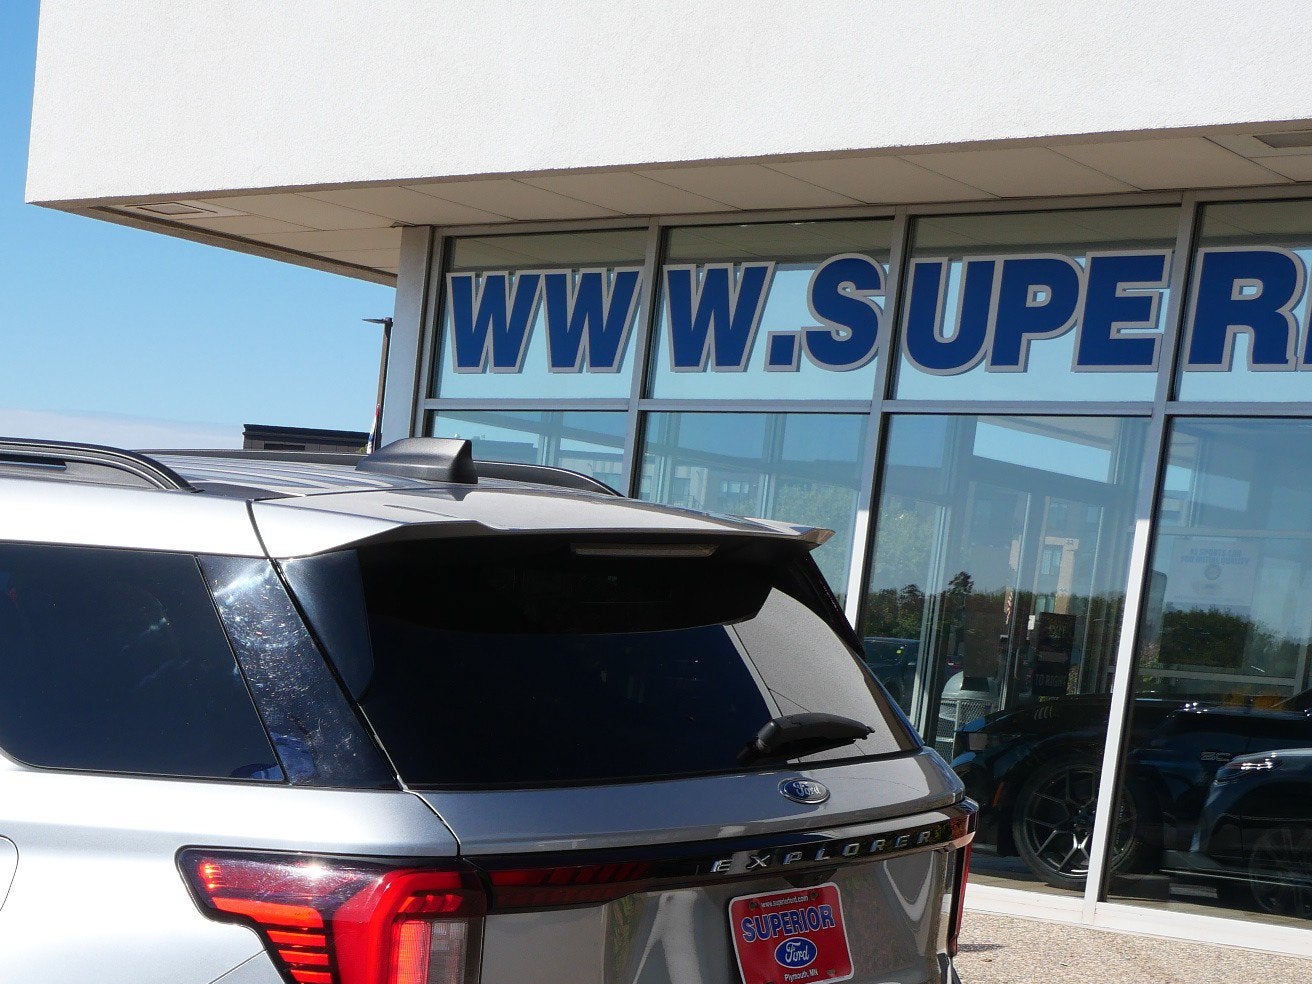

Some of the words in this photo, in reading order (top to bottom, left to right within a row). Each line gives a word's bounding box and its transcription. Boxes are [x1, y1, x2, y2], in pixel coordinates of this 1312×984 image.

[446, 245, 1312, 376] WWW.SUPER
[792, 781, 821, 797] Ford
[710, 830, 931, 873] EXPLORER
[741, 904, 836, 943] SUPERIOR
[784, 941, 810, 963] Ford
